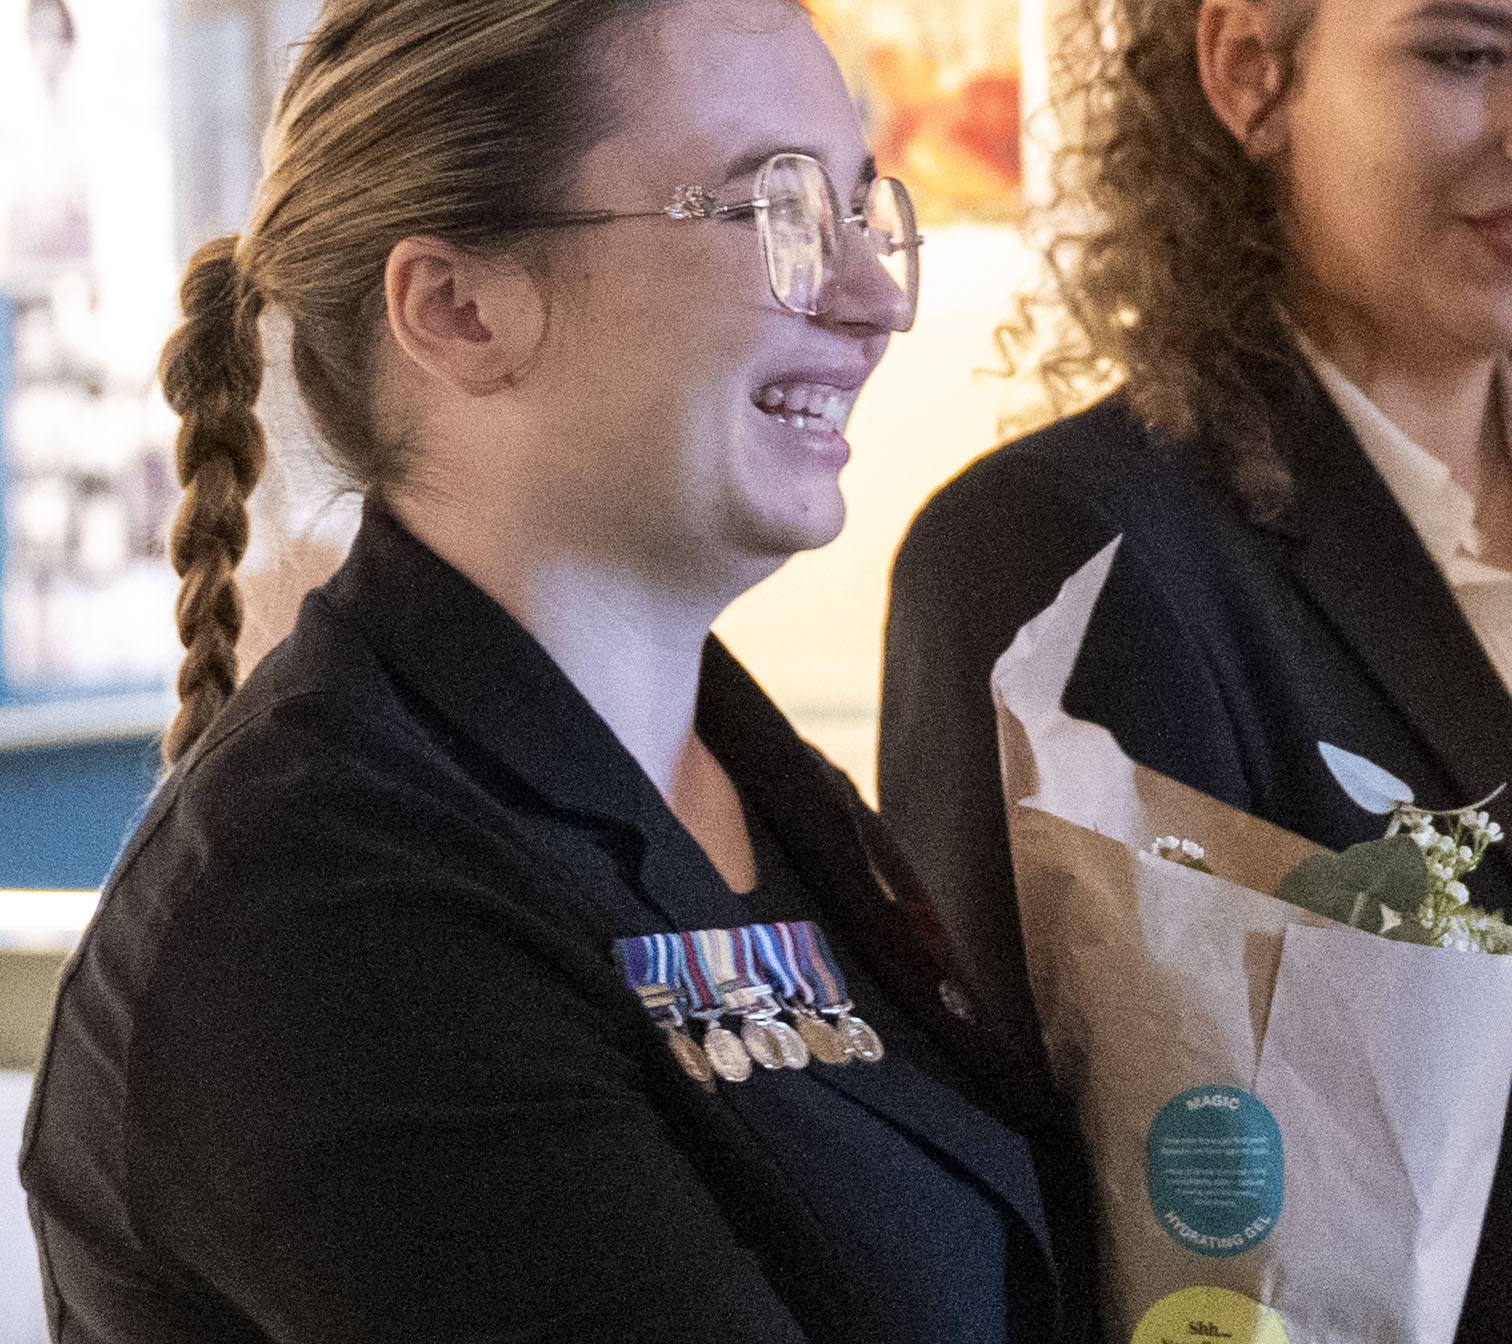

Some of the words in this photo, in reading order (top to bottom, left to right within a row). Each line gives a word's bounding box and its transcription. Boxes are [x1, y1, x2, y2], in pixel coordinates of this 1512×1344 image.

[1186, 1094, 1241, 1111] MAGIC
[1164, 1210, 1244, 1248] HYDRATING
[1244, 1215, 1272, 1239] GEL
